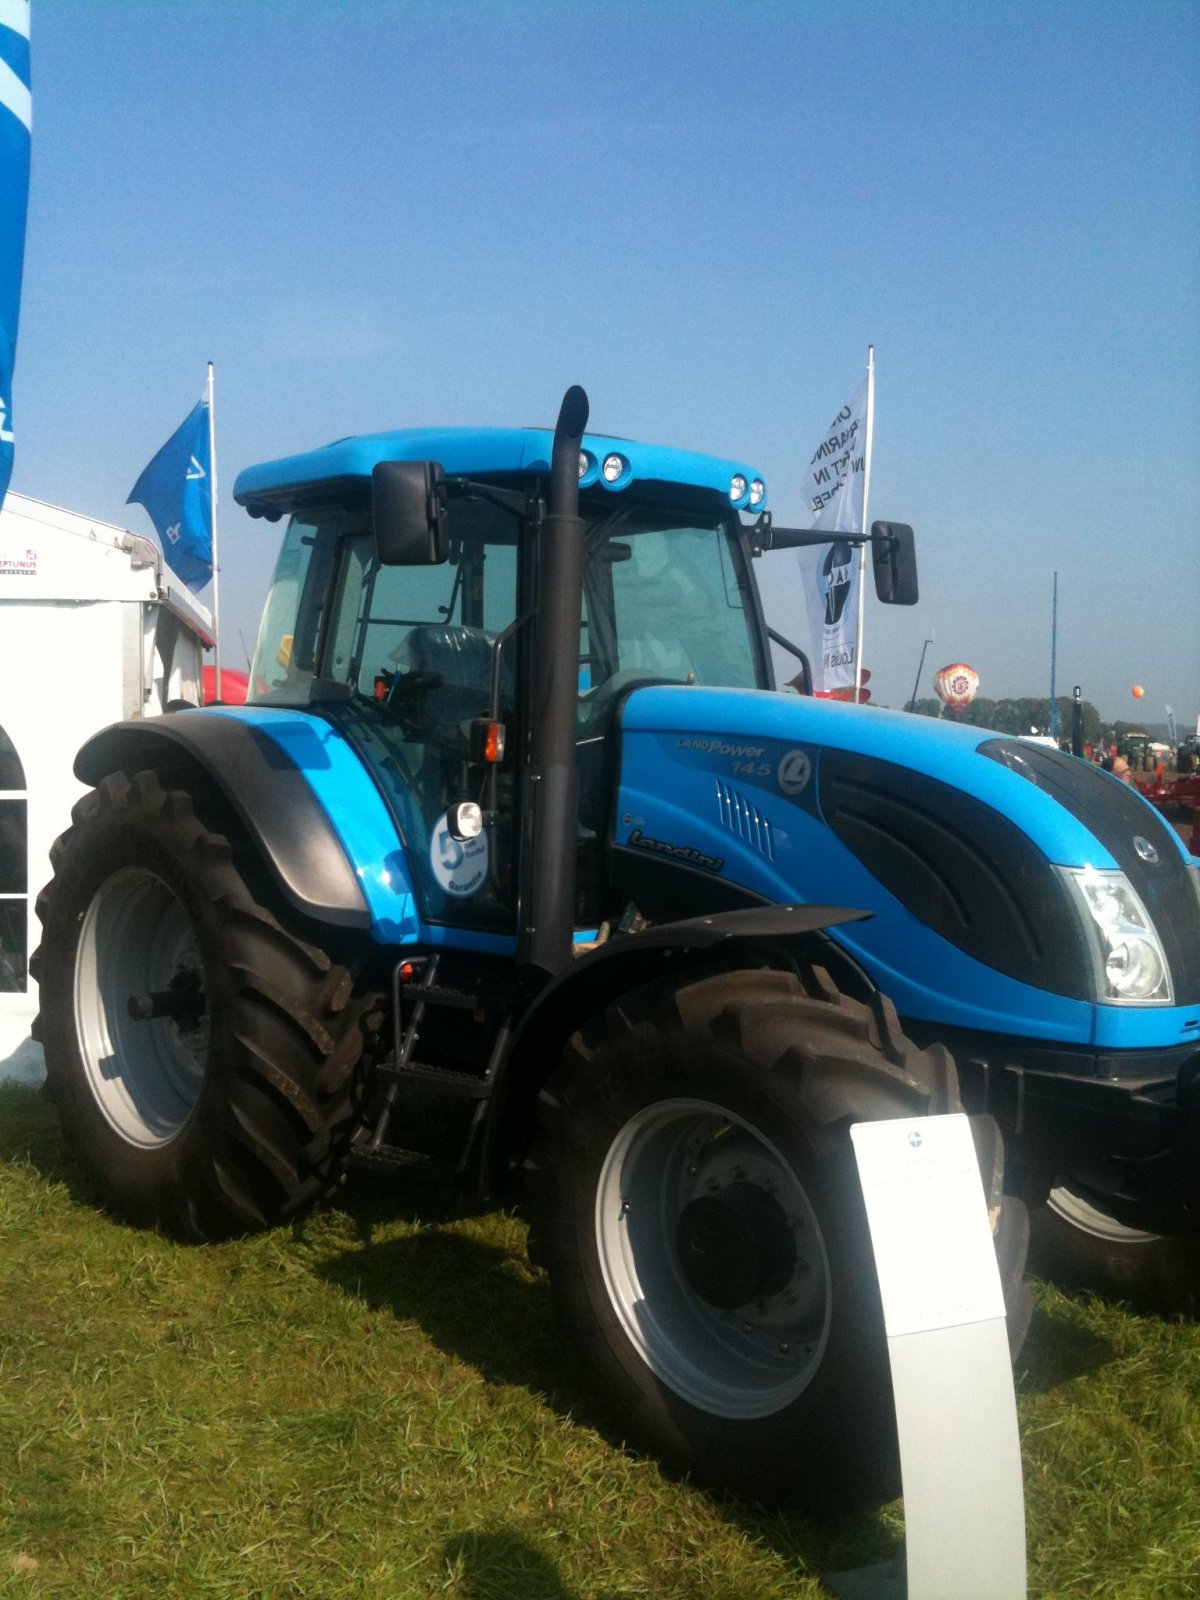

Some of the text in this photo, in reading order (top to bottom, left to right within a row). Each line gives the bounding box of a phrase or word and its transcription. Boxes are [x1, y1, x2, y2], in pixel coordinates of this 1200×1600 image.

[0, 560, 37, 569] EPTUNUS
[731, 760, 773, 776] 145
[439, 830, 464, 870] 5
[628, 829, 725, 872] Landini
